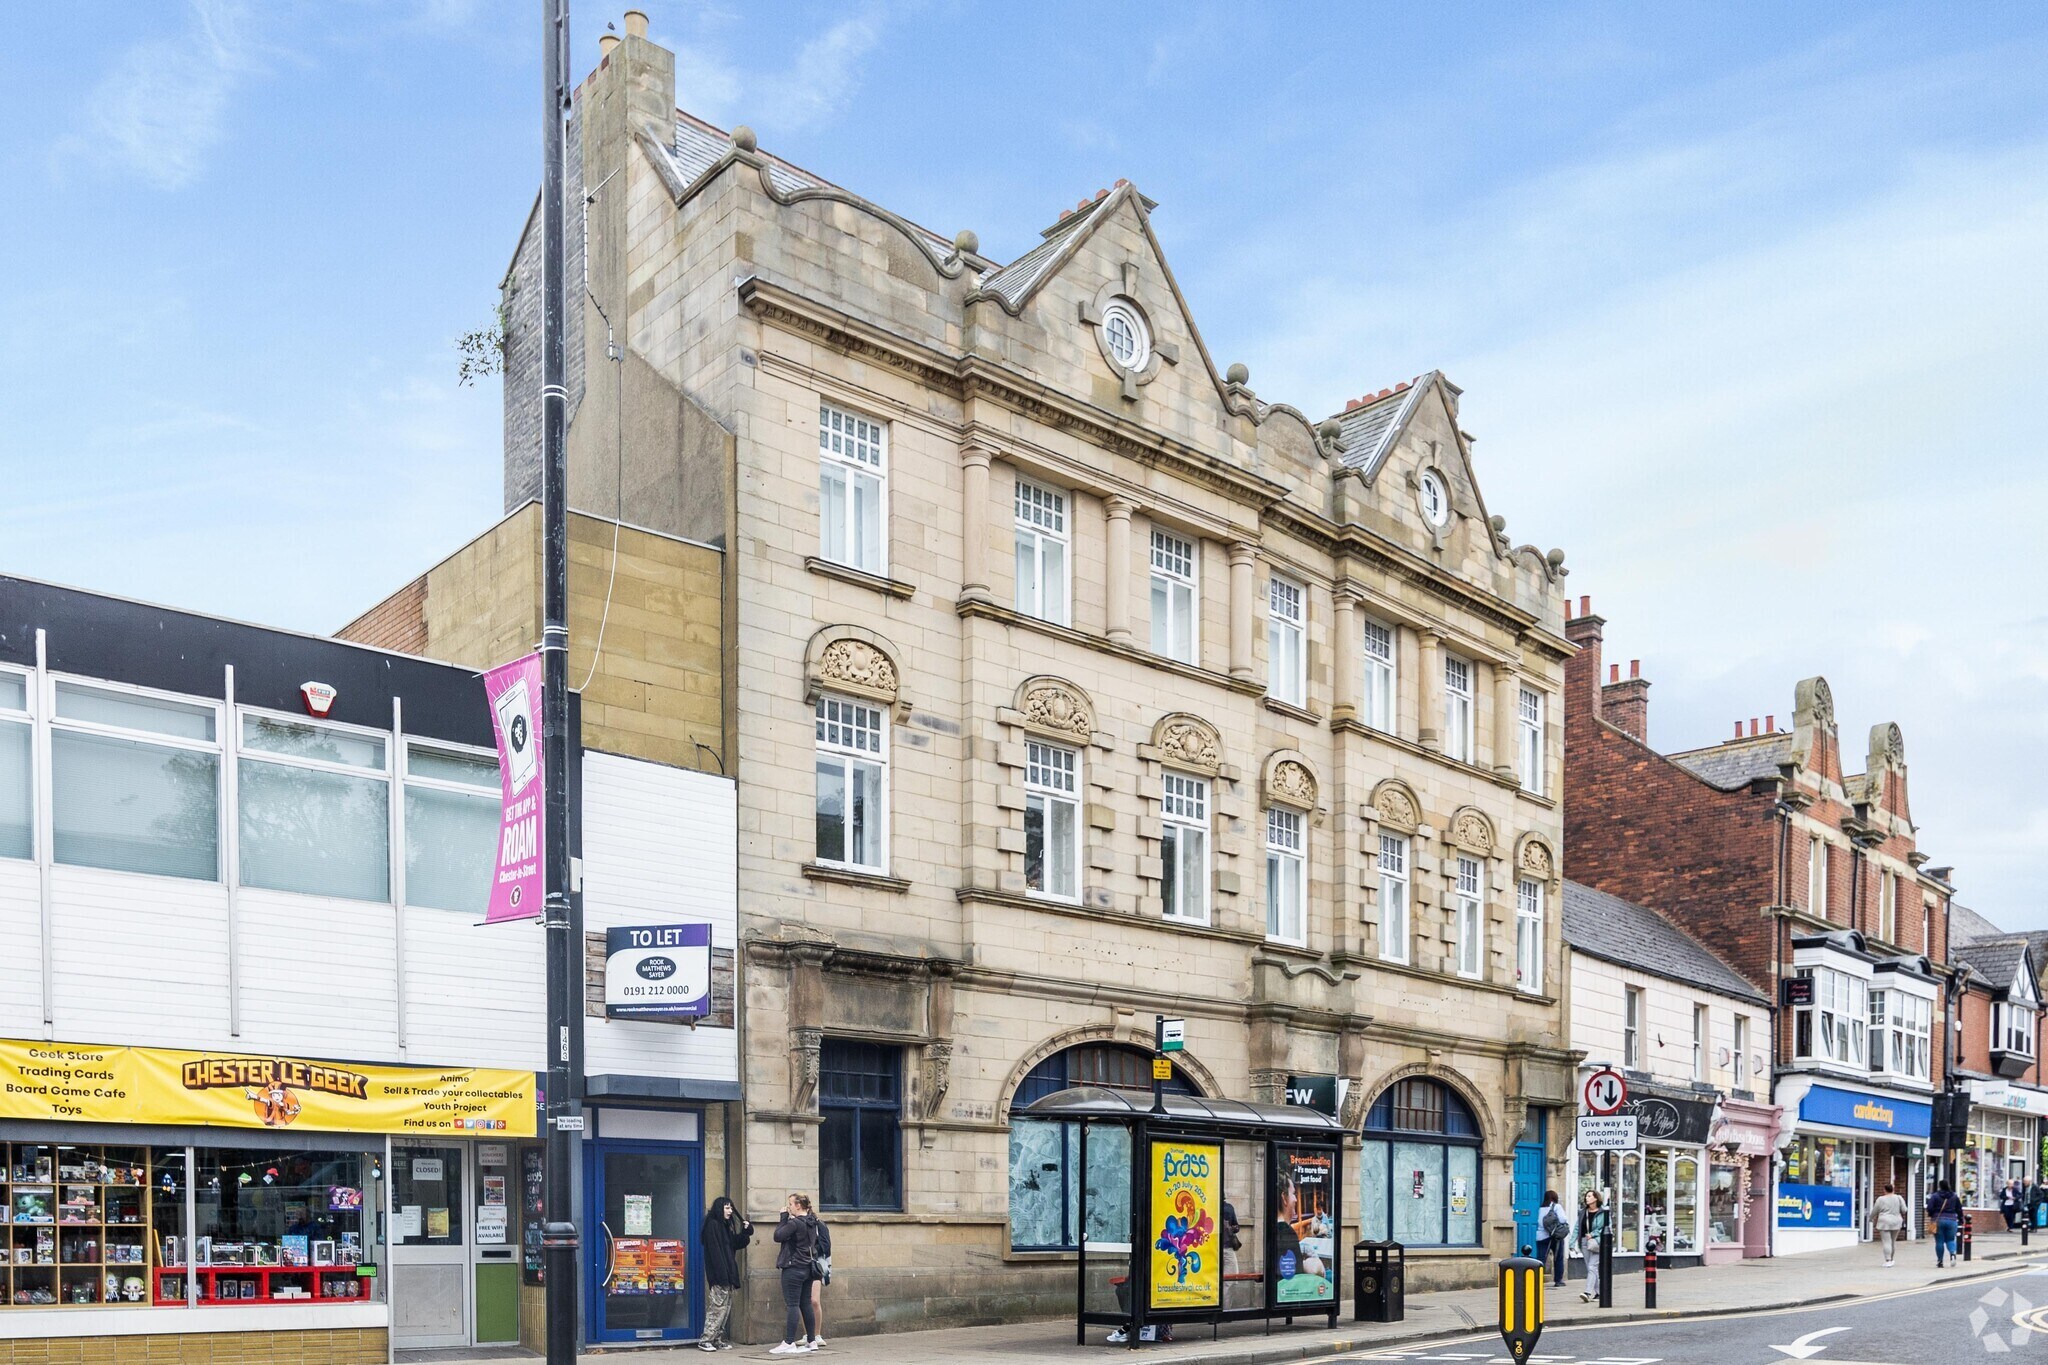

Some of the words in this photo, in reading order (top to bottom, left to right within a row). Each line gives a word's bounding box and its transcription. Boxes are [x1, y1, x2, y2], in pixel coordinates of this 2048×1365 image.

[505, 805, 514, 822] GET
[514, 801, 522, 819] THE
[522, 797, 531, 815] APP
[531, 795, 537, 811] &
[501, 815, 537, 867] ROAM
[499, 862, 537, 884] Chester-le-Street
[630, 930, 653, 947] TO
[656, 929, 682, 946] LET
[648, 971, 665, 979] SAYER
[623, 986, 646, 996] 0191
[648, 986, 665, 995] 212
[666, 985, 690, 995] 0000
[28, 1048, 64, 1059] Geek
[66, 1051, 104, 1062] Store
[18, 1065, 71, 1080] Trading
[74, 1069, 115, 1080] Cards
[183, 1059, 275, 1088] CHESTER
[280, 1061, 308, 1088] LE
[310, 1065, 368, 1099] GEEK
[439, 1074, 470, 1083] Anime
[6, 1083, 48, 1095] Board
[50, 1086, 91, 1097] Game
[93, 1088, 126, 1099] Cafe
[383, 1086, 402, 1095] Sell
[403, 1087, 410, 1095] &
[411, 1087, 440, 1096] Trade
[442, 1090, 463, 1100] your
[464, 1089, 524, 1099] collectables
[52, 1104, 83, 1116] Toys
[423, 1102, 451, 1111] Youth
[453, 1103, 487, 1113] Project
[1853, 1099, 1894, 1129] cardfactory
[403, 1118, 424, 1127] Find
[1580, 1119, 1600, 1128] Give
[1603, 1120, 1621, 1128] way
[1624, 1119, 1634, 1127] to
[1585, 1128, 1629, 1137] oncoming
[1588, 1138, 1625, 1146] vehicles
[1290, 1154, 1331, 1168] Breastfeeding
[1317, 1166, 1329, 1175] than
[1300, 1174, 1310, 1184] just
[1310, 1174, 1322, 1183] food
[1181, 1180, 1194, 1191] July
[1194, 1184, 1207, 1203] 2025
[1157, 1282, 1212, 1293] brassfestival.co.uk
